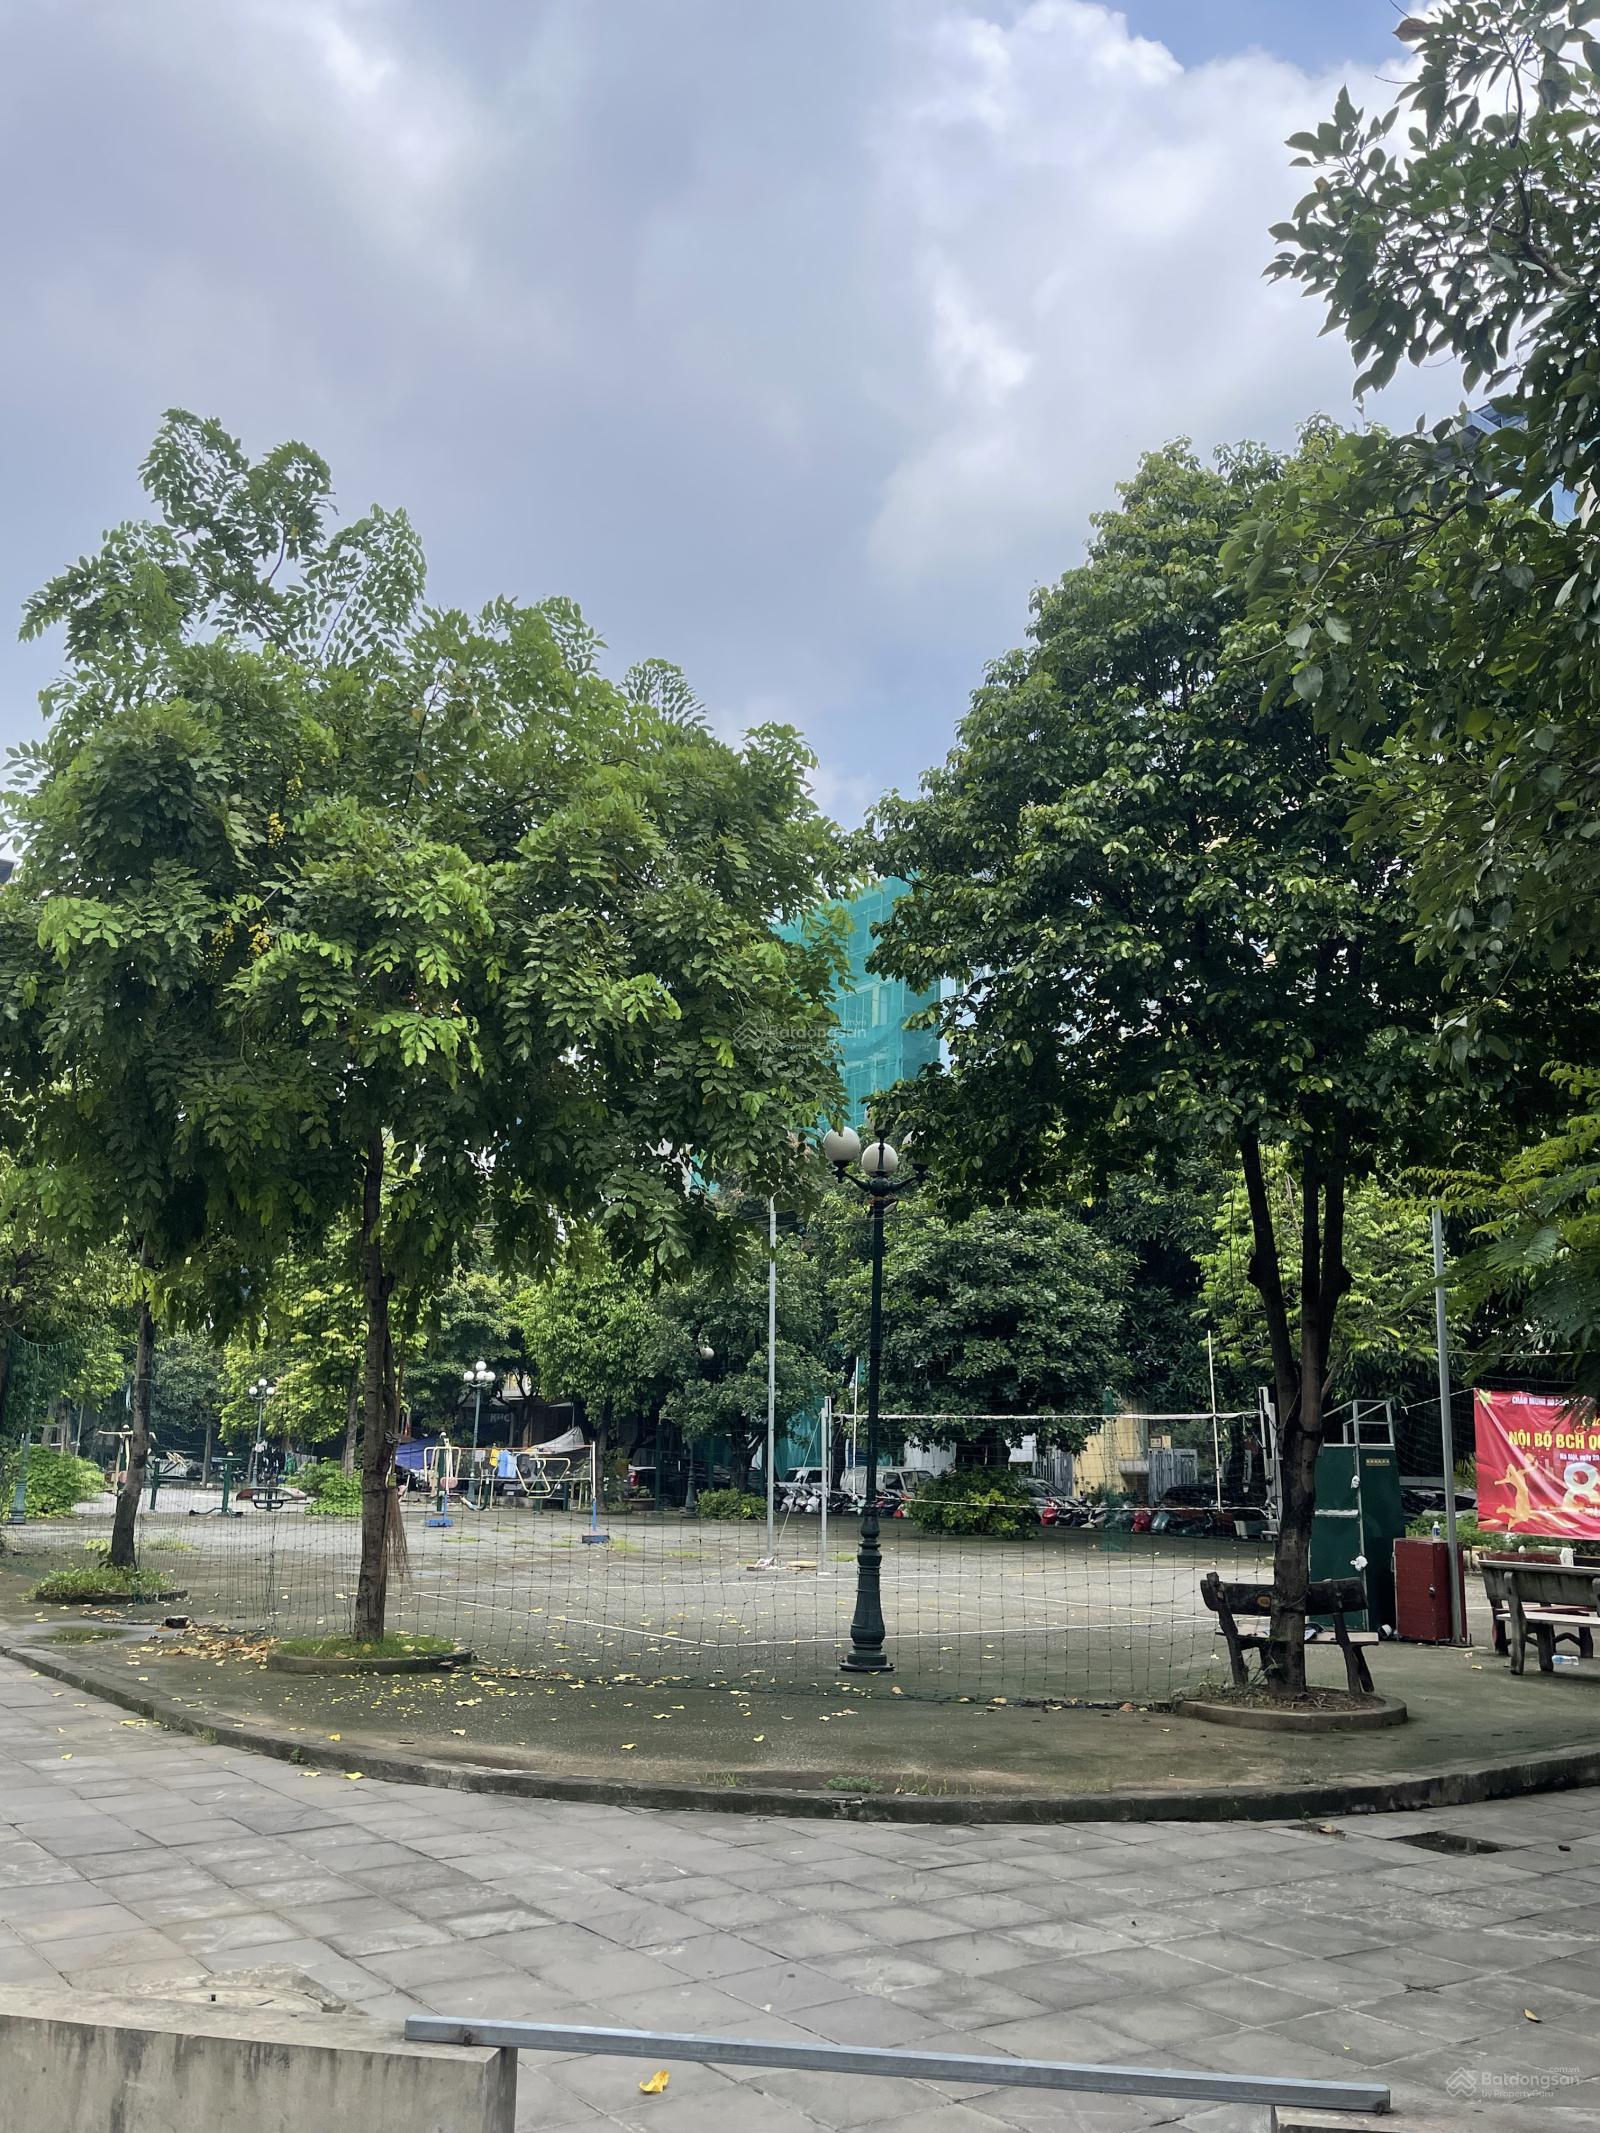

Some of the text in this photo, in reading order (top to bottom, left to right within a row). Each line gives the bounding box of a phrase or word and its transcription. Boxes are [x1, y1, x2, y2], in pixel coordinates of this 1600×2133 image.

[1509, 1429, 1600, 1451] NỘI BỘ BCH Q
